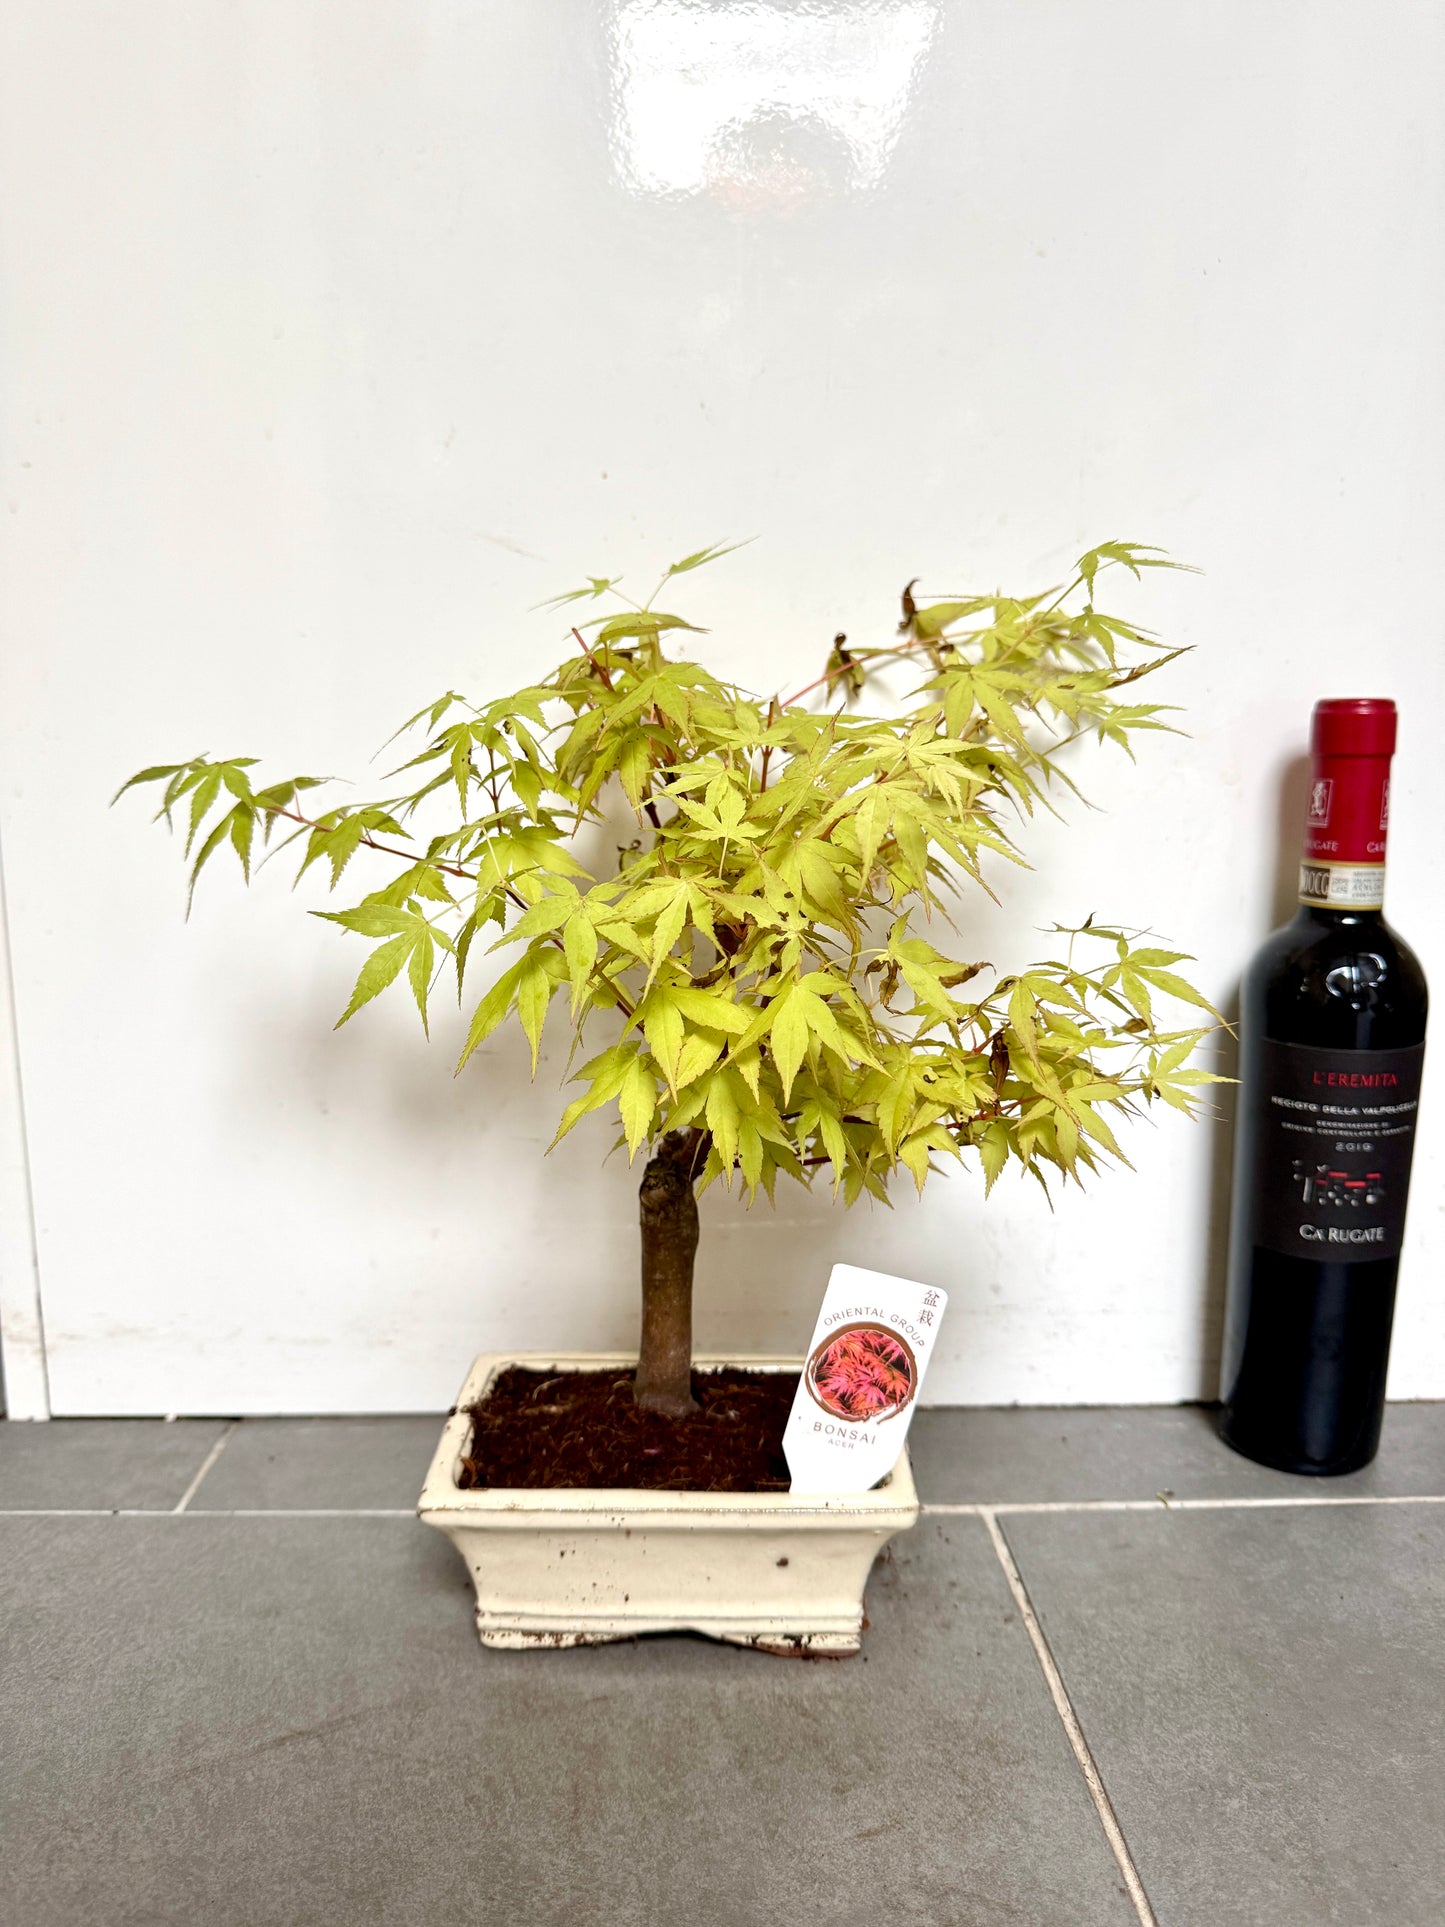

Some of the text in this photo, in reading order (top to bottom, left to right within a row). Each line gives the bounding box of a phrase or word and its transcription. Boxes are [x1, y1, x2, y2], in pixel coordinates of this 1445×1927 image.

[1312, 1071, 1398, 1088] L'EREMITA
[1322, 1104, 1359, 1116] DELLA
[1328, 1226, 1385, 1244] RUGATE
[917, 1289, 940, 1327] 盆栽
[823, 1306, 926, 1348] ORIENTAL GROUP
[813, 1421, 877, 1445] BONSAI
[827, 1438, 855, 1450] ACER
